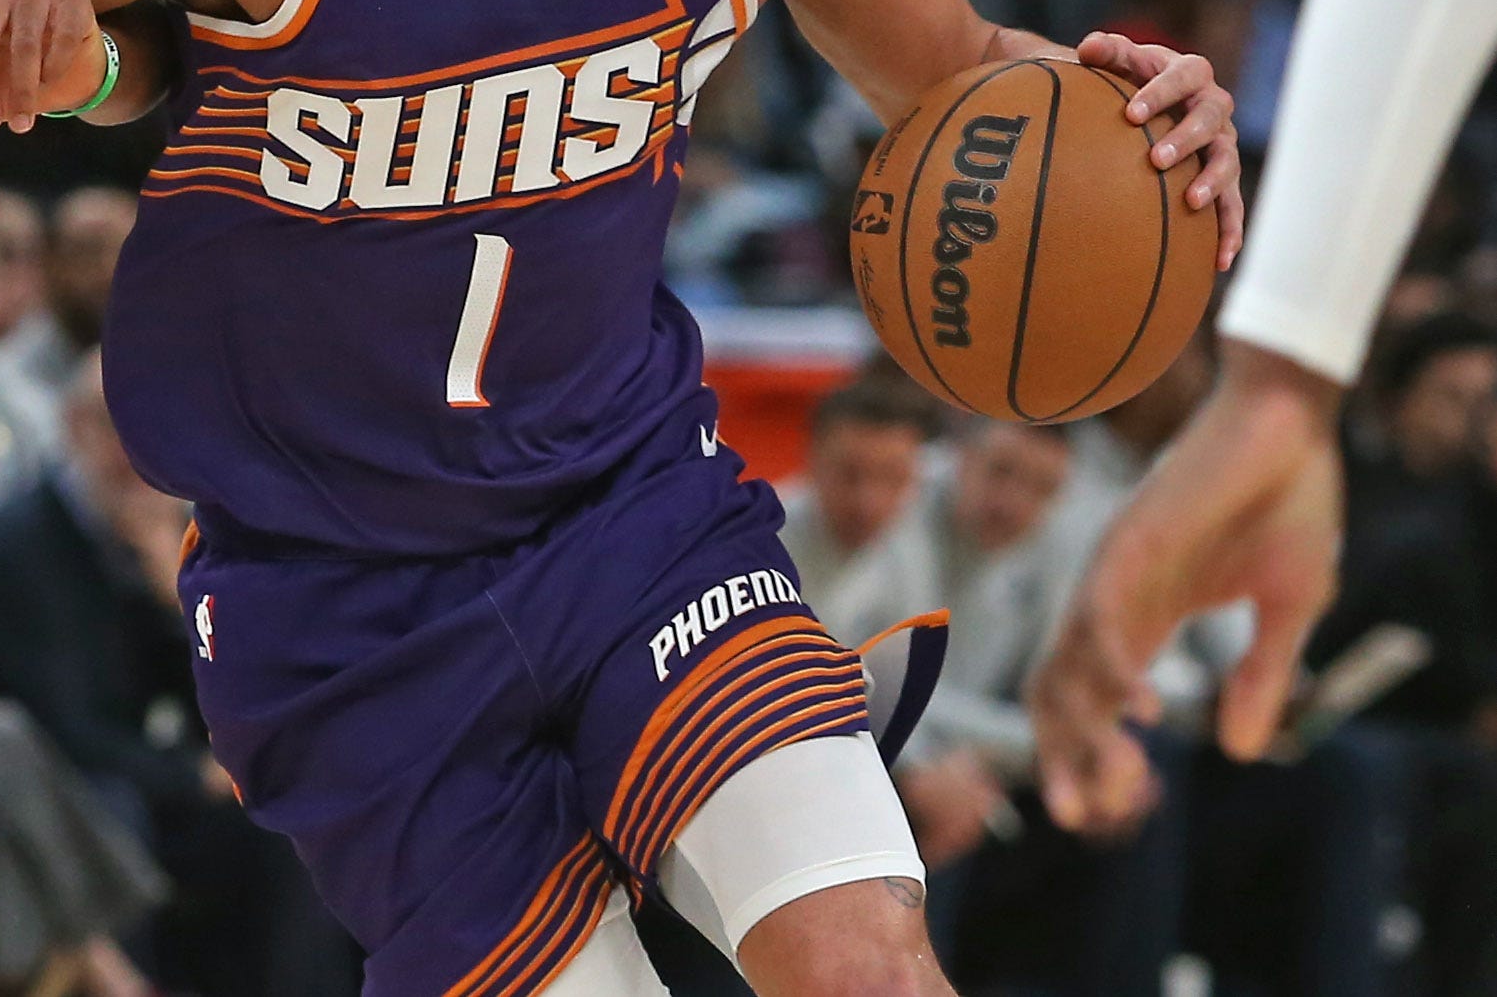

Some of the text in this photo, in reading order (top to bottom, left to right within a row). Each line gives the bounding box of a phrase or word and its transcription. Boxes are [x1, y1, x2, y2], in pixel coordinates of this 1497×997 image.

[259, 36, 662, 211] SUNS
[930, 114, 1030, 349] Wilson
[446, 232, 514, 408] 1
